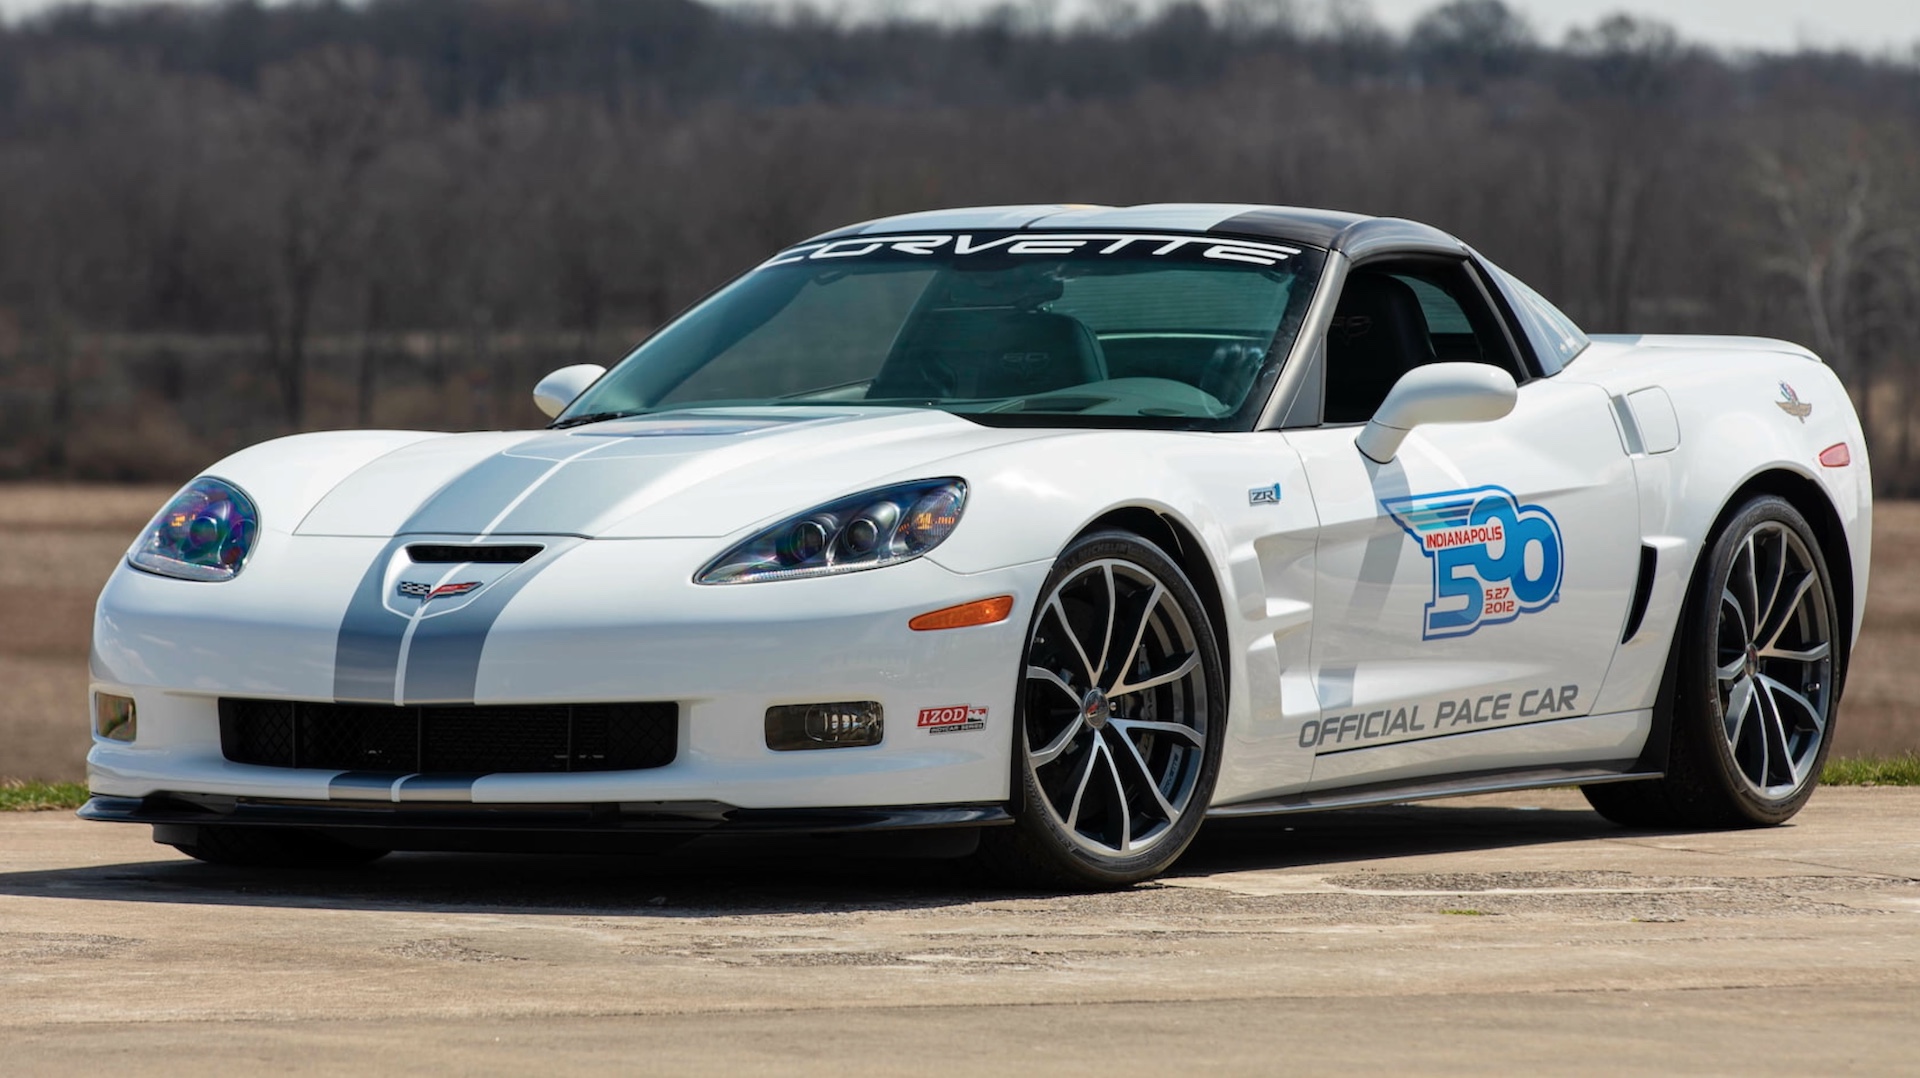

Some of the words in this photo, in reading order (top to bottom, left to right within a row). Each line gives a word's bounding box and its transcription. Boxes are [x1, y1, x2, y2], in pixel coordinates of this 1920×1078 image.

[755, 233, 1301, 266] CORVETTE
[1251, 483, 1281, 502] ZR1
[1426, 525, 1503, 549] INDIANAPOLIS
[1428, 494, 1560, 631] 500
[1485, 586, 1511, 601] 5.27
[1484, 600, 1515, 615] 2012
[920, 707, 966, 724] IZOD
[1298, 704, 1426, 749] OFFICIAL
[1433, 693, 1512, 729] PACE
[1518, 684, 1579, 717] CAR
